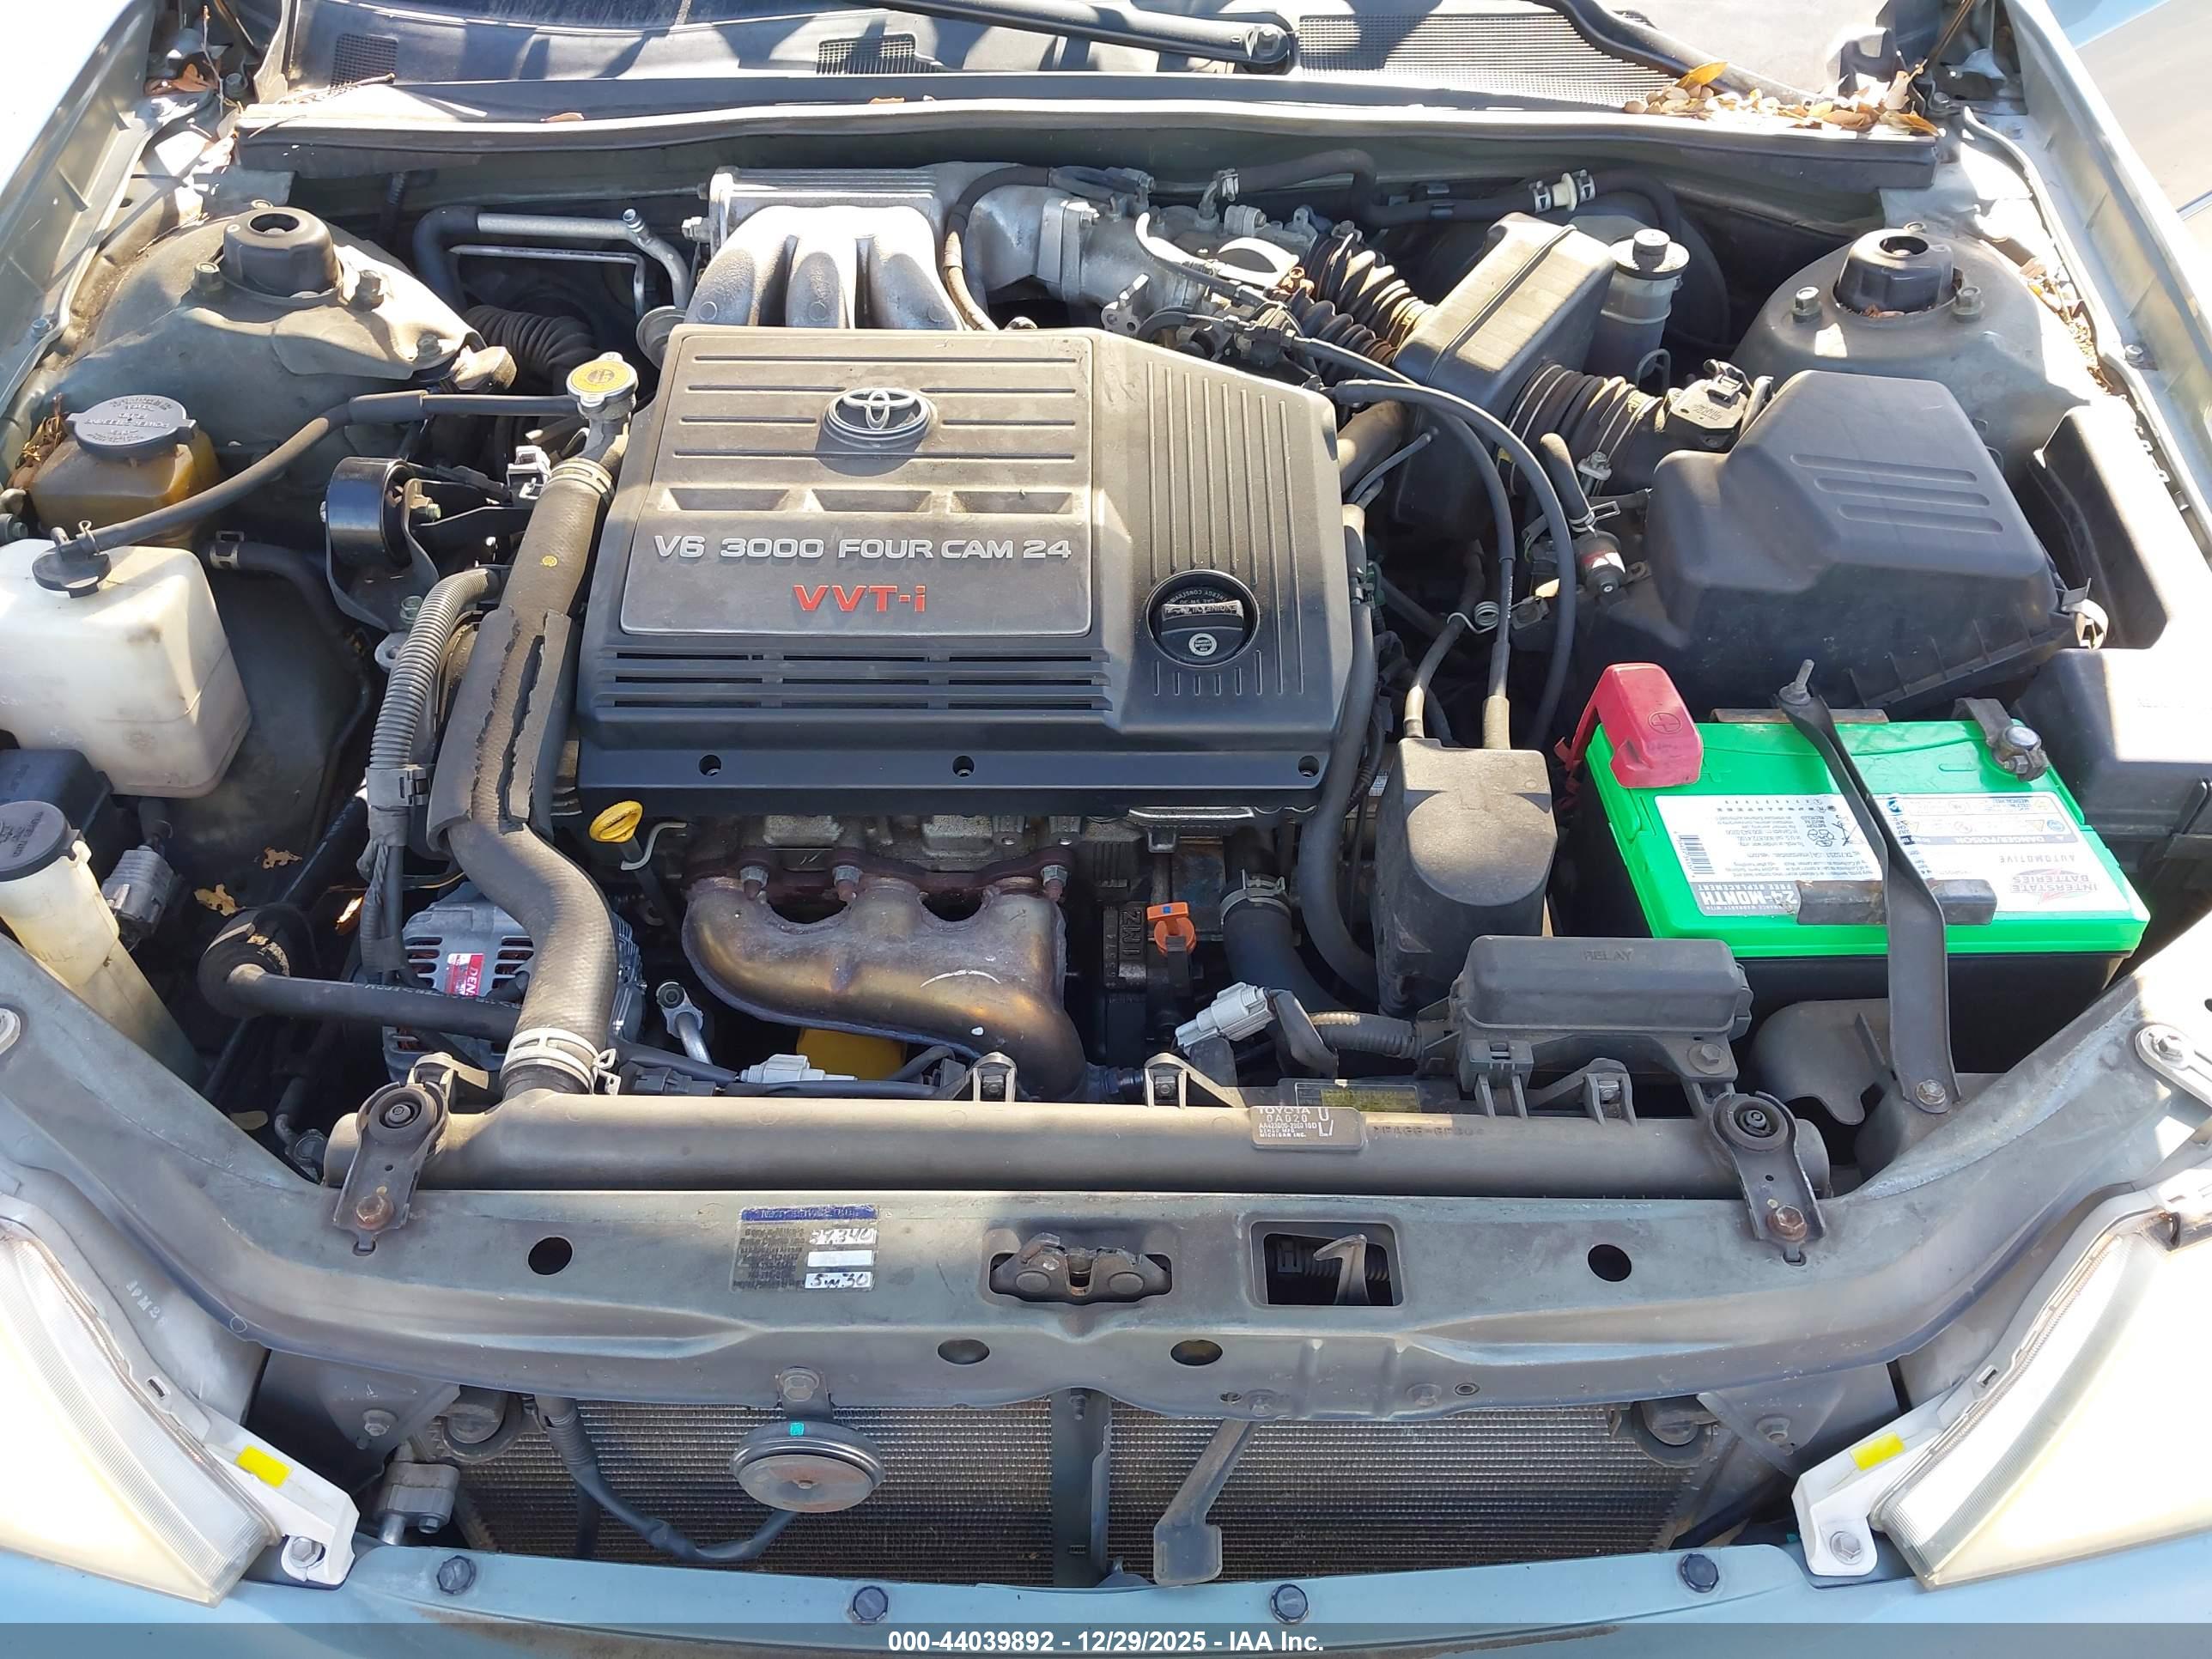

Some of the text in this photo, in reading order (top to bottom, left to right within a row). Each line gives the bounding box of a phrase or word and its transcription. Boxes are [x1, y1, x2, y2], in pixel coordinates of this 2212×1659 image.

[653, 535, 1073, 561] V6 3000 FOUR CAM 24
[792, 584, 927, 614] VVT-i
[1998, 854, 2075, 864] AUTOMOTIVE
[2012, 874, 2089, 884] BATTERIES
[2011, 883, 2098, 894] INTERSTATE
